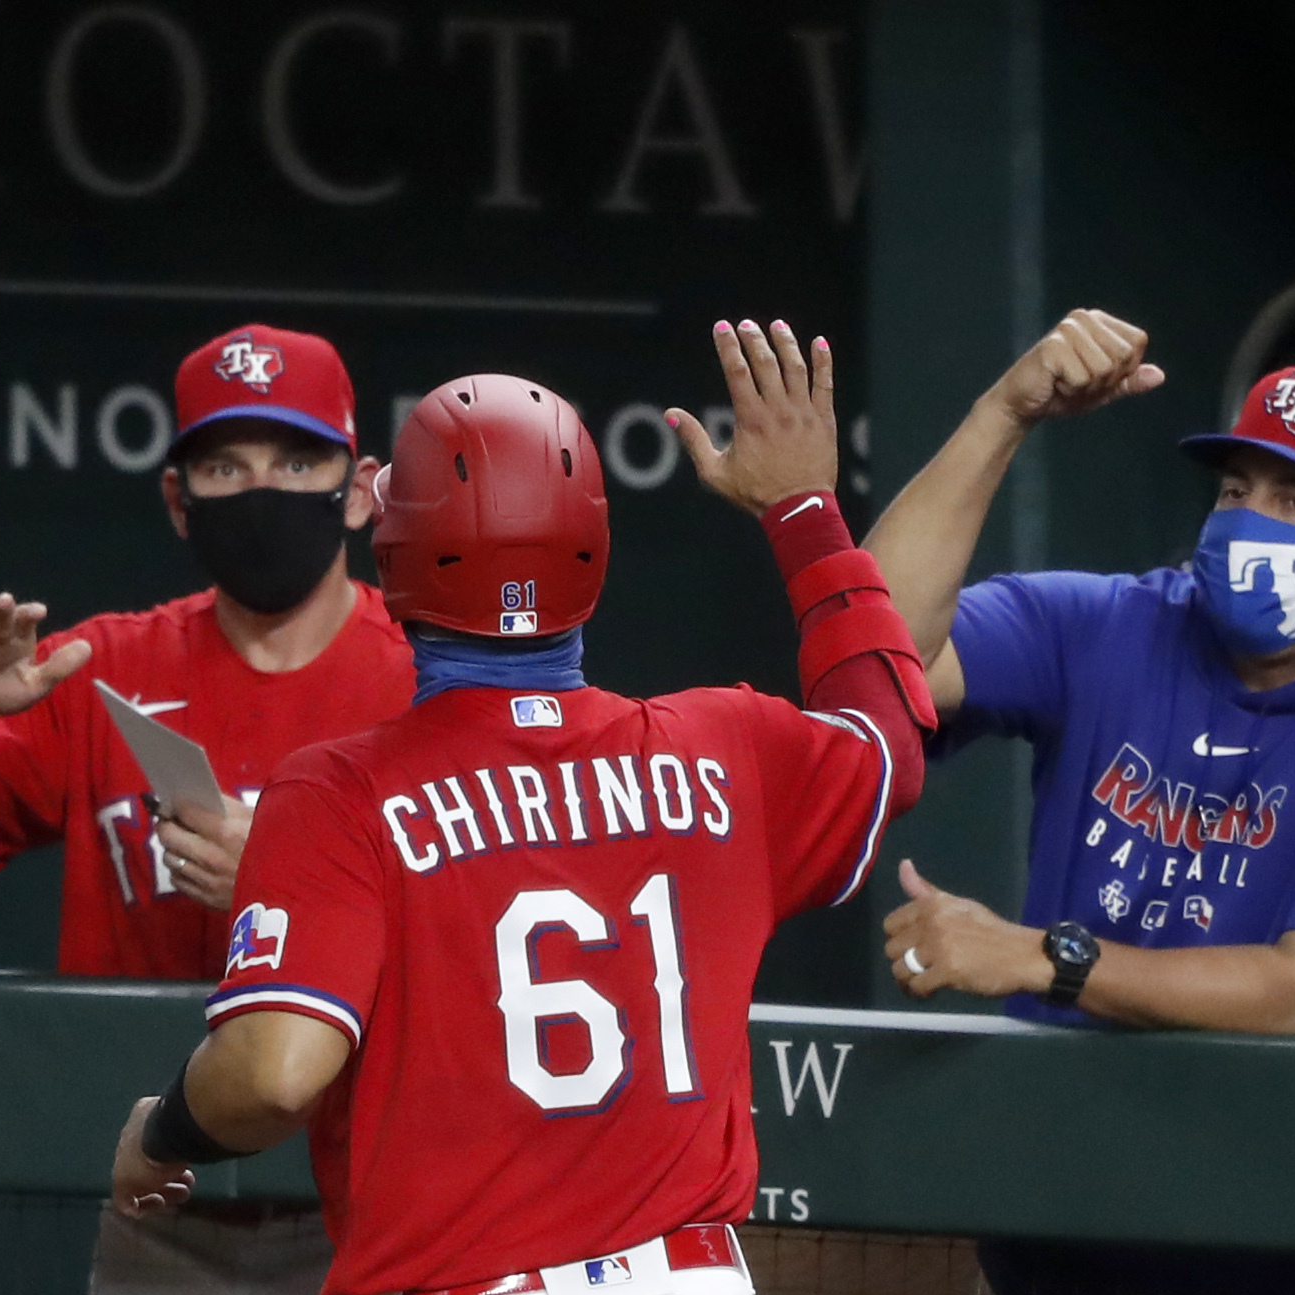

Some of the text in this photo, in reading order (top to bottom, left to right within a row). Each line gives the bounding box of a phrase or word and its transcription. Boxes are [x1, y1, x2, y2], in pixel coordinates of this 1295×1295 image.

[220, 340, 275, 385] TX
[500, 578, 537, 612] 61
[381, 752, 731, 876] CHIRINOS
[1091, 742, 1289, 855] RANGRS
[1085, 817, 1248, 888] BAEALL
[494, 872, 703, 1120] 61
